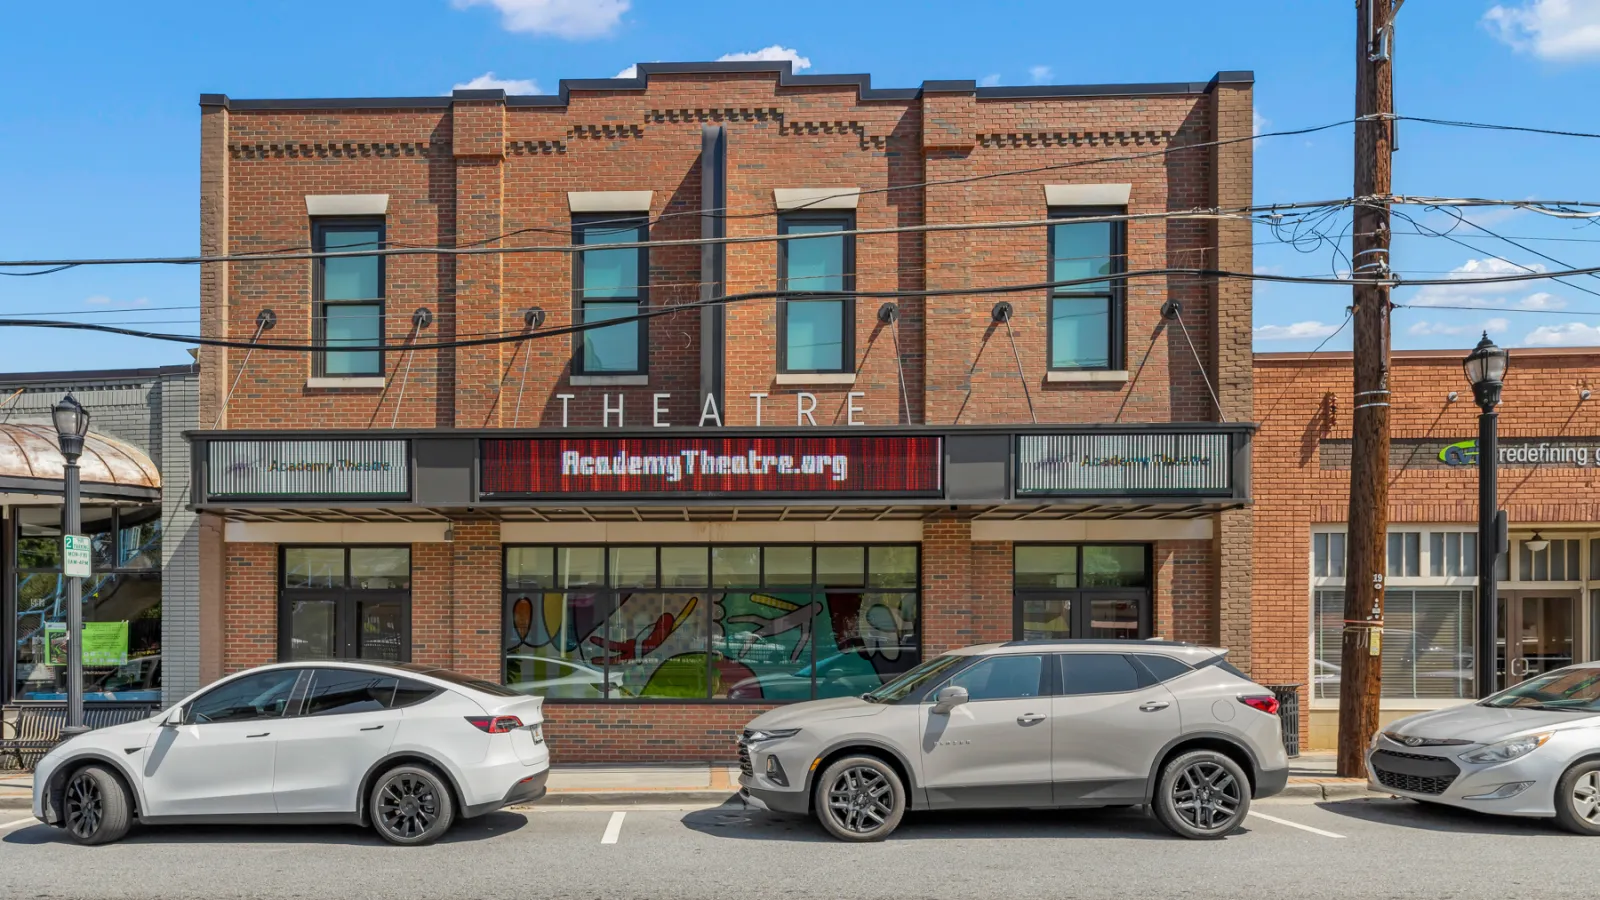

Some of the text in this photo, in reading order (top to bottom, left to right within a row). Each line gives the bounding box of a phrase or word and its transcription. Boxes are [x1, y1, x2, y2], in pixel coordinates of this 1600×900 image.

[556, 392, 865, 428] THEATRE
[562, 450, 848, 482] AcademyTheatre.org
[1499, 443, 1588, 466] redefining
